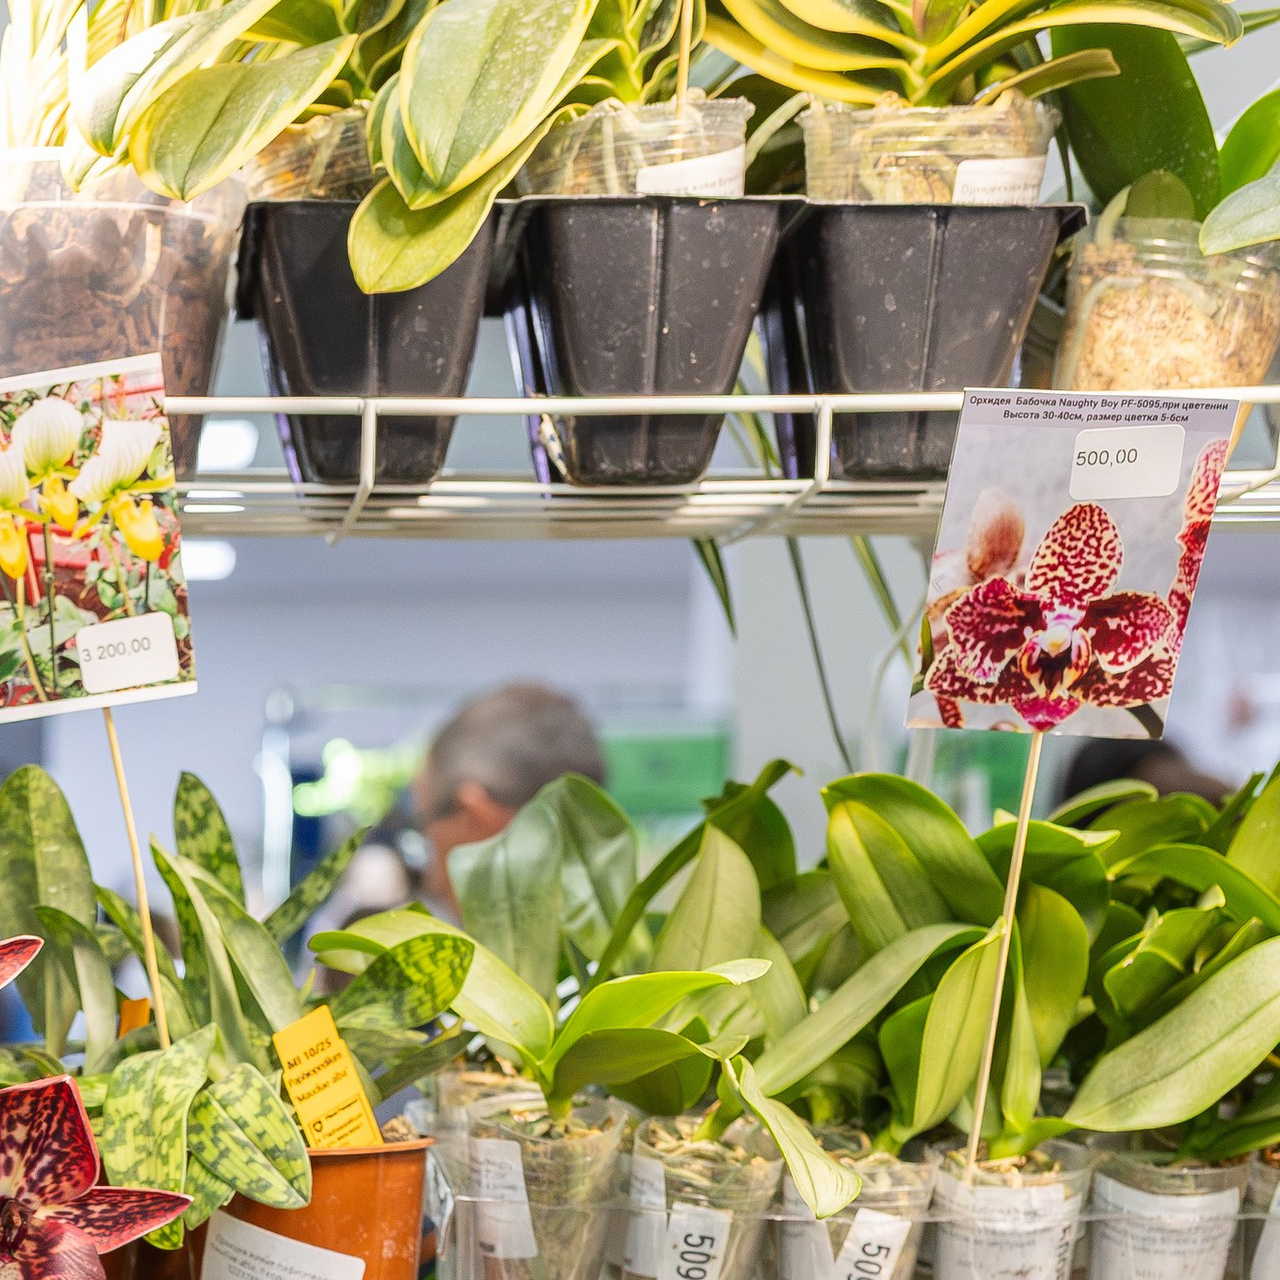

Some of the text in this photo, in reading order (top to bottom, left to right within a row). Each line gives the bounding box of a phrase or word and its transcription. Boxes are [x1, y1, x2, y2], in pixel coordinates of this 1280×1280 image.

[970, 395, 1011, 406] Орхидея
[1016, 396, 1057, 406] Бабочка
[1059, 398, 1098, 409] Naughty
[1101, 399, 1118, 410] Boy
[1181, 402, 1229, 412] цветении
[1003, 409, 1189, 424] Высота 30-40см, размер цветка 5-6см
[1076, 448, 1138, 467] 500,00
[82, 636, 151, 662] 3 200,00
